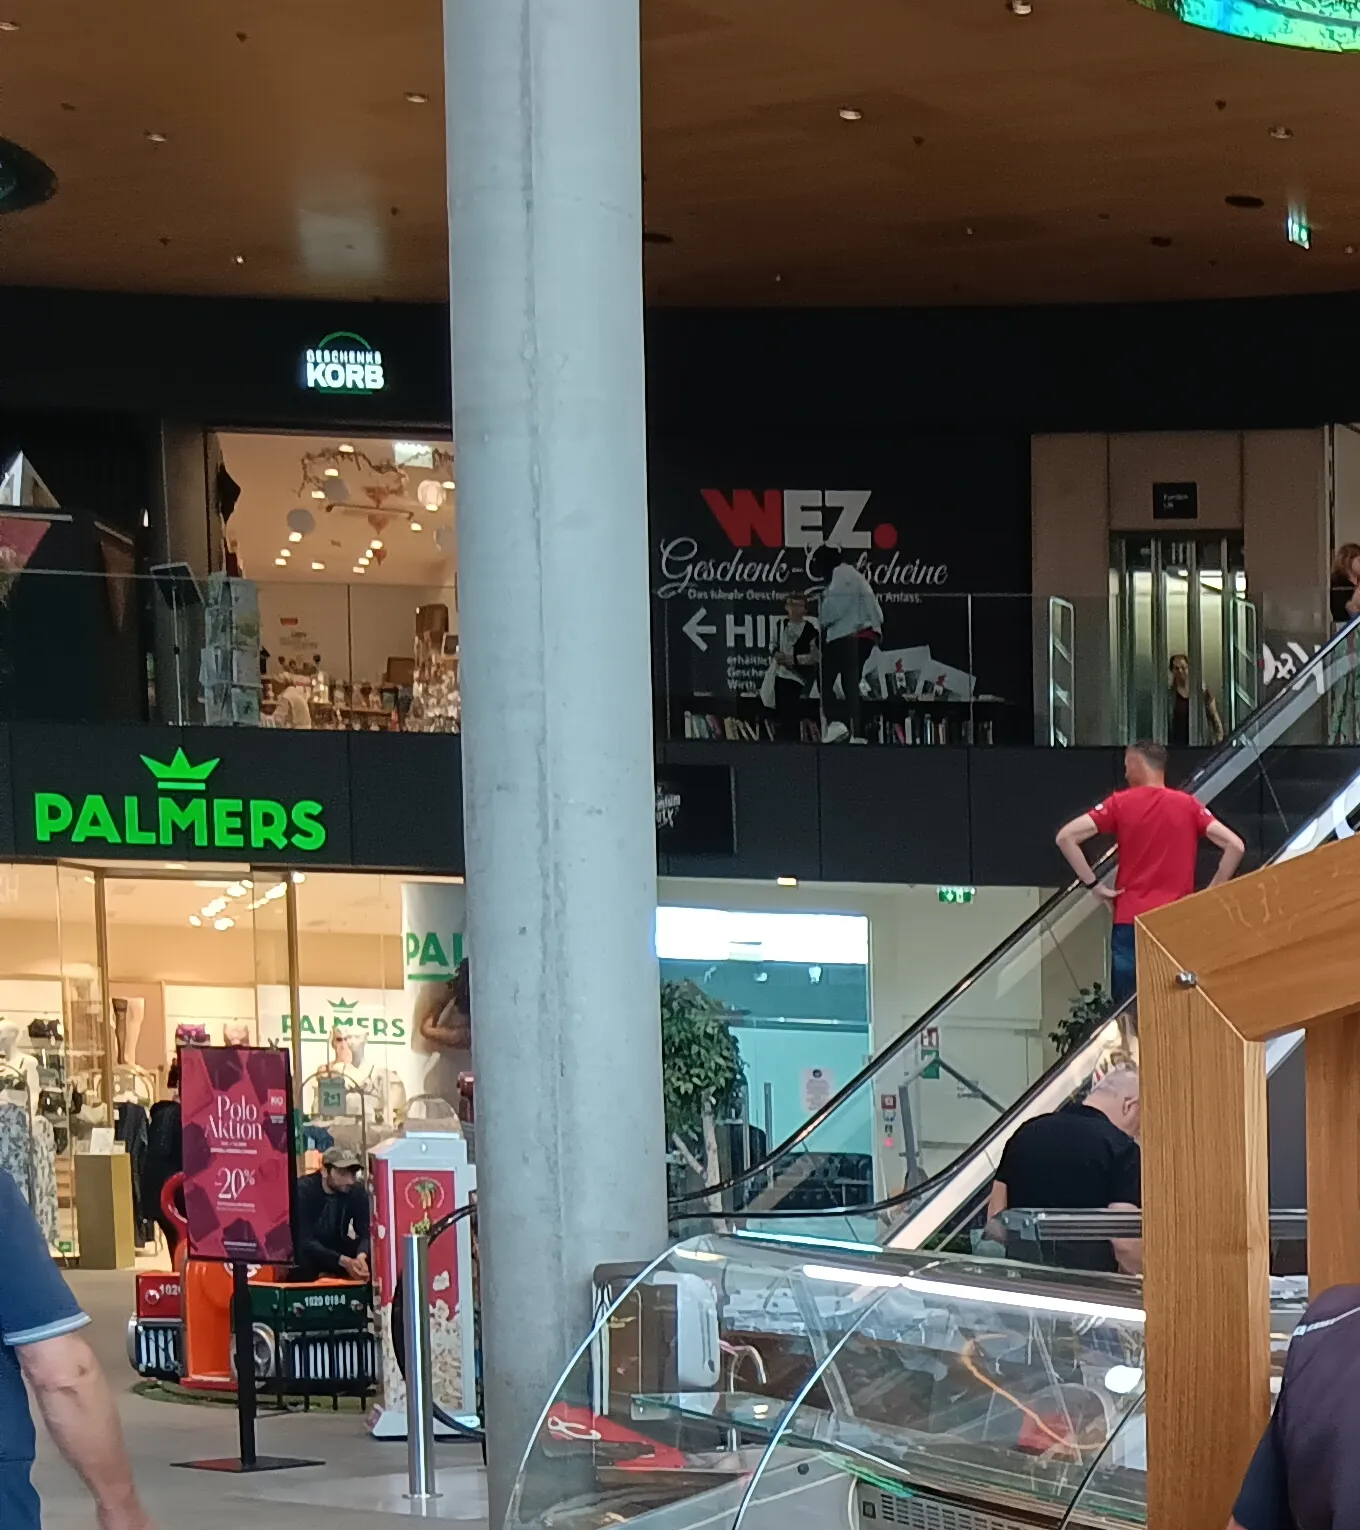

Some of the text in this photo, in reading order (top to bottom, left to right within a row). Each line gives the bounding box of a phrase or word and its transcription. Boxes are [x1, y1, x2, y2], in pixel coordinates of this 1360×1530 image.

[306, 362, 385, 389] KORB
[34, 792, 328, 851] PALMERS
[217, 1094, 257, 1121] Polo
[204, 1114, 263, 1141] Aktion
[214, 1167, 256, 1201] -20%
